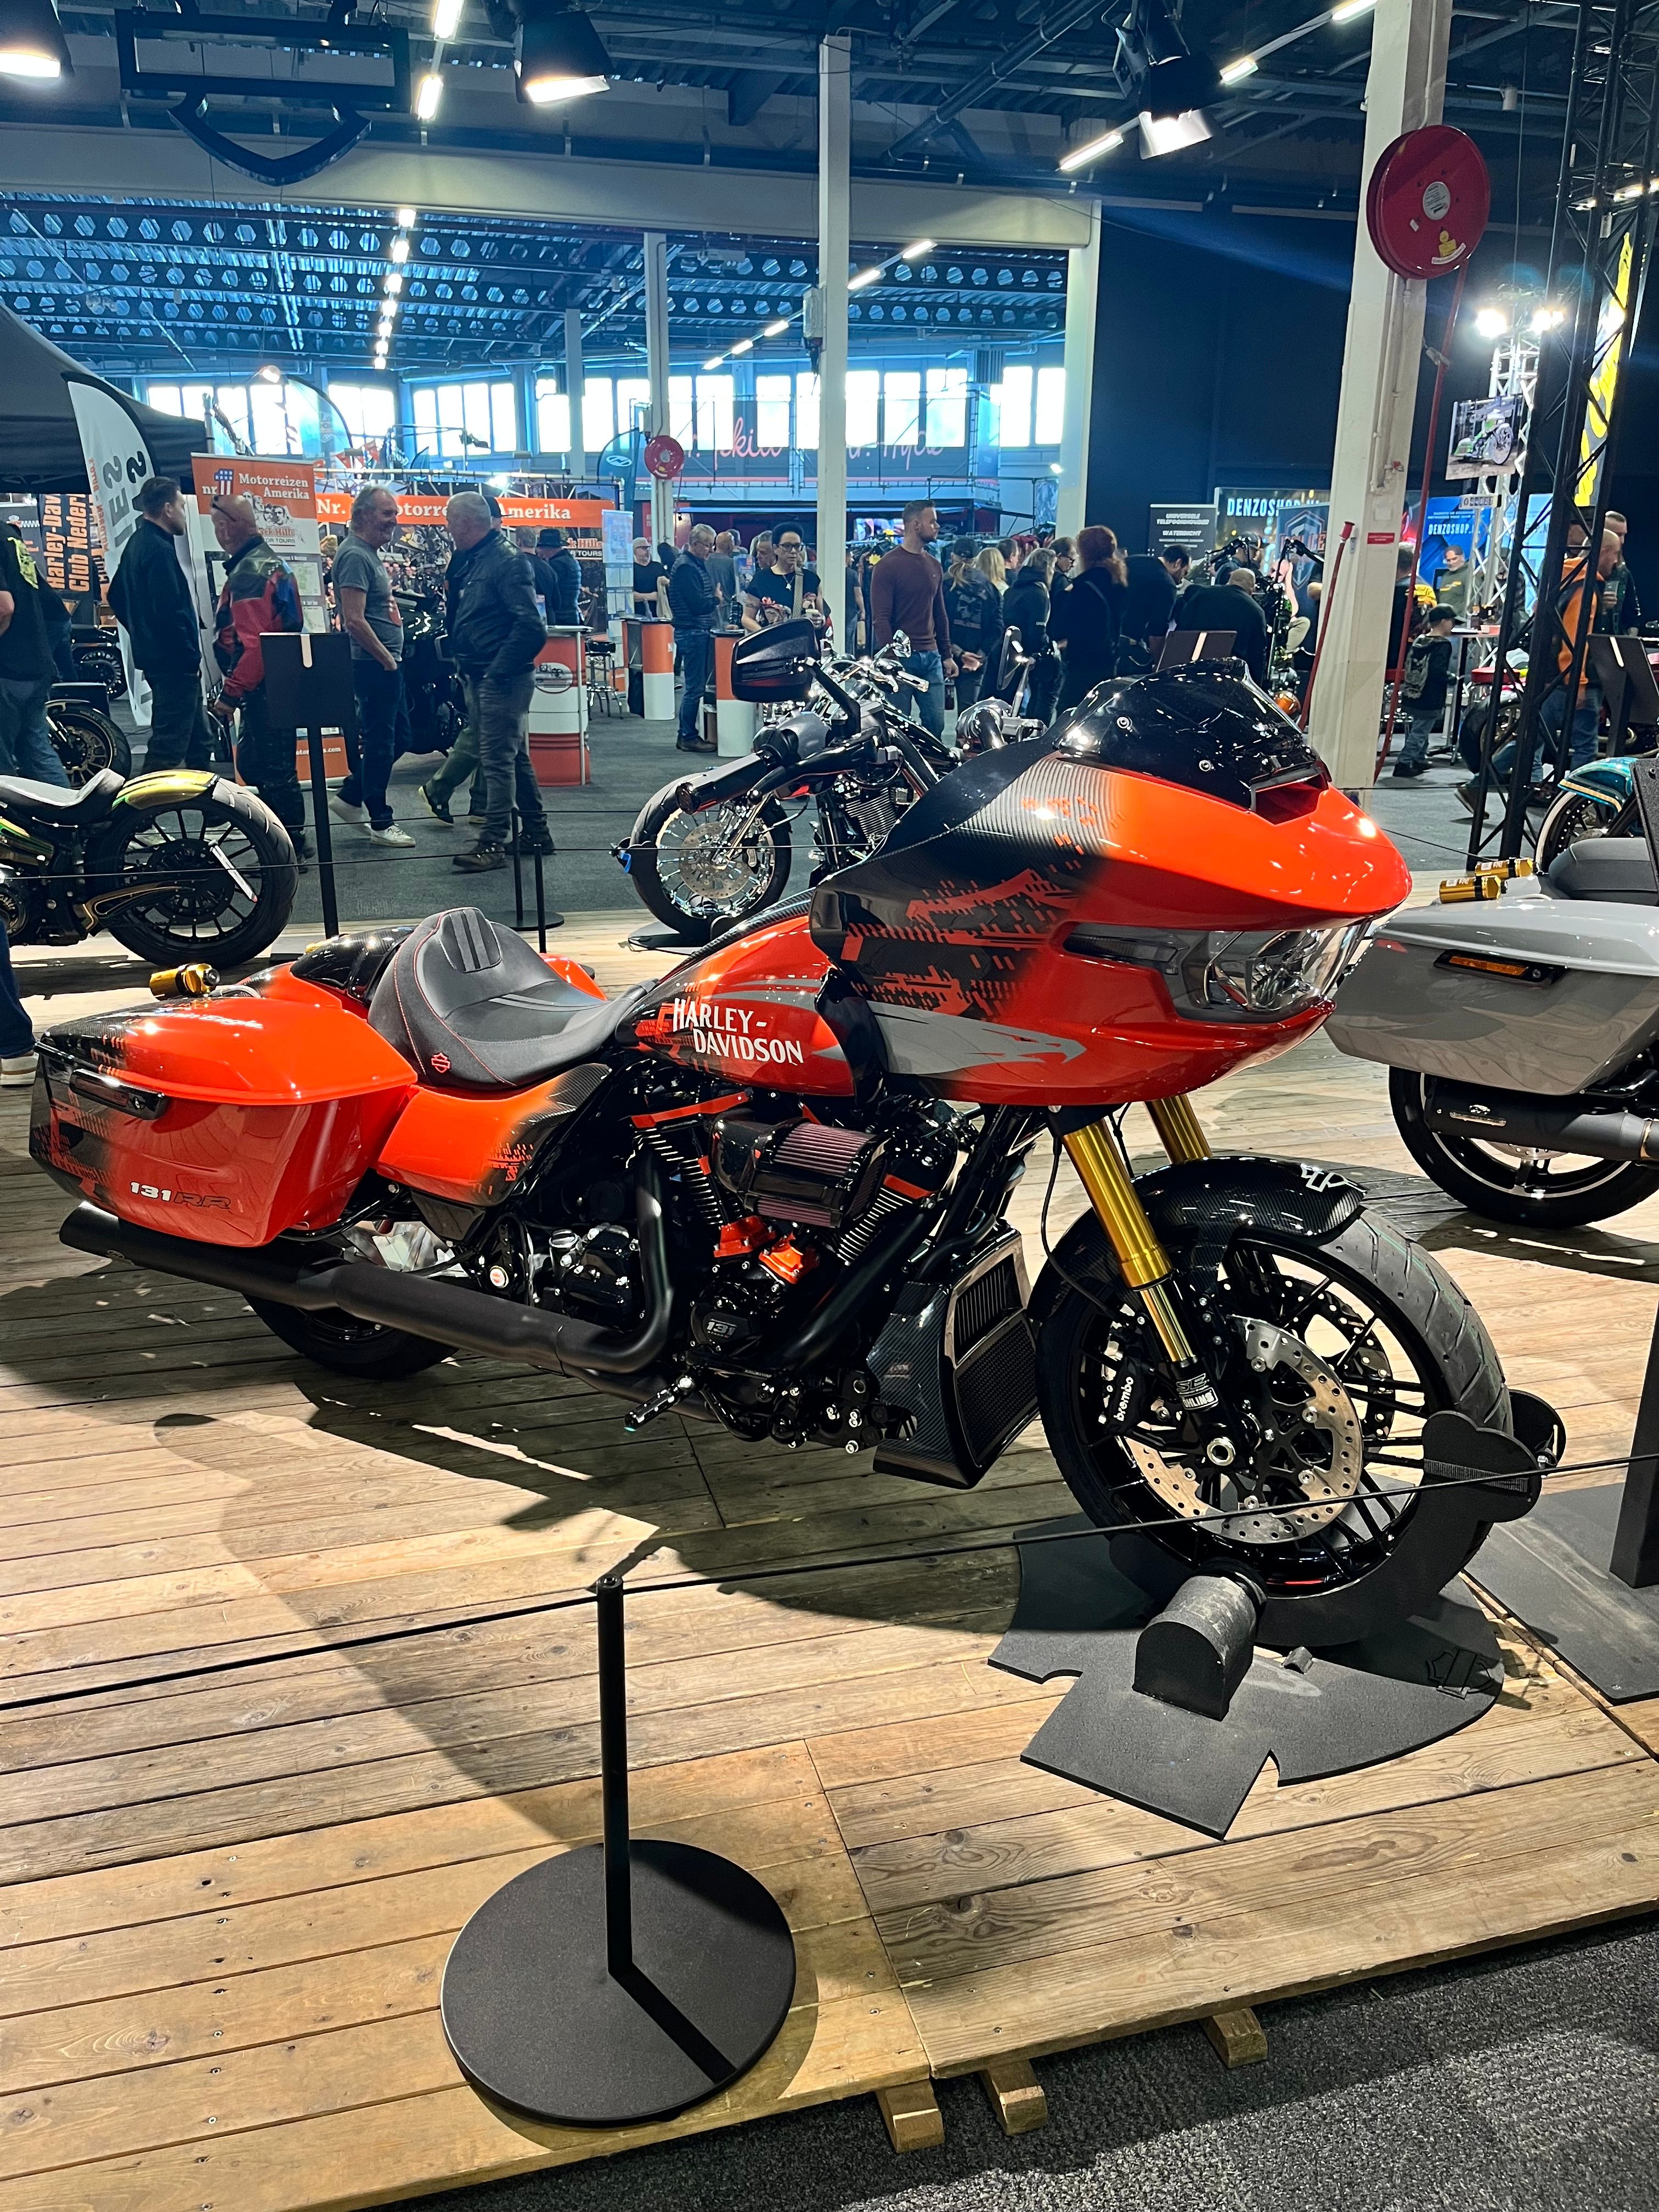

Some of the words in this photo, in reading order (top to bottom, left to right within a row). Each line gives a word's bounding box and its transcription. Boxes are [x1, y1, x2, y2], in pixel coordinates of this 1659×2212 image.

[238, 473, 309, 488] Motorreizen
[263, 487, 310, 500] Amerika
[66, 494, 88, 549] Neder
[317, 499, 346, 515] Nr.
[396, 501, 448, 517] otorre
[43, 494, 66, 589] Harley-Dav
[1428, 523, 1481, 535] DENZOSHOP.
[68, 554, 90, 592] Club
[673, 998, 768, 1034] HARLEY-
[692, 1028, 804, 1066] DAVIDSON
[707, 1322, 736, 1336] 131
[1113, 1376, 1134, 1422] brembo
